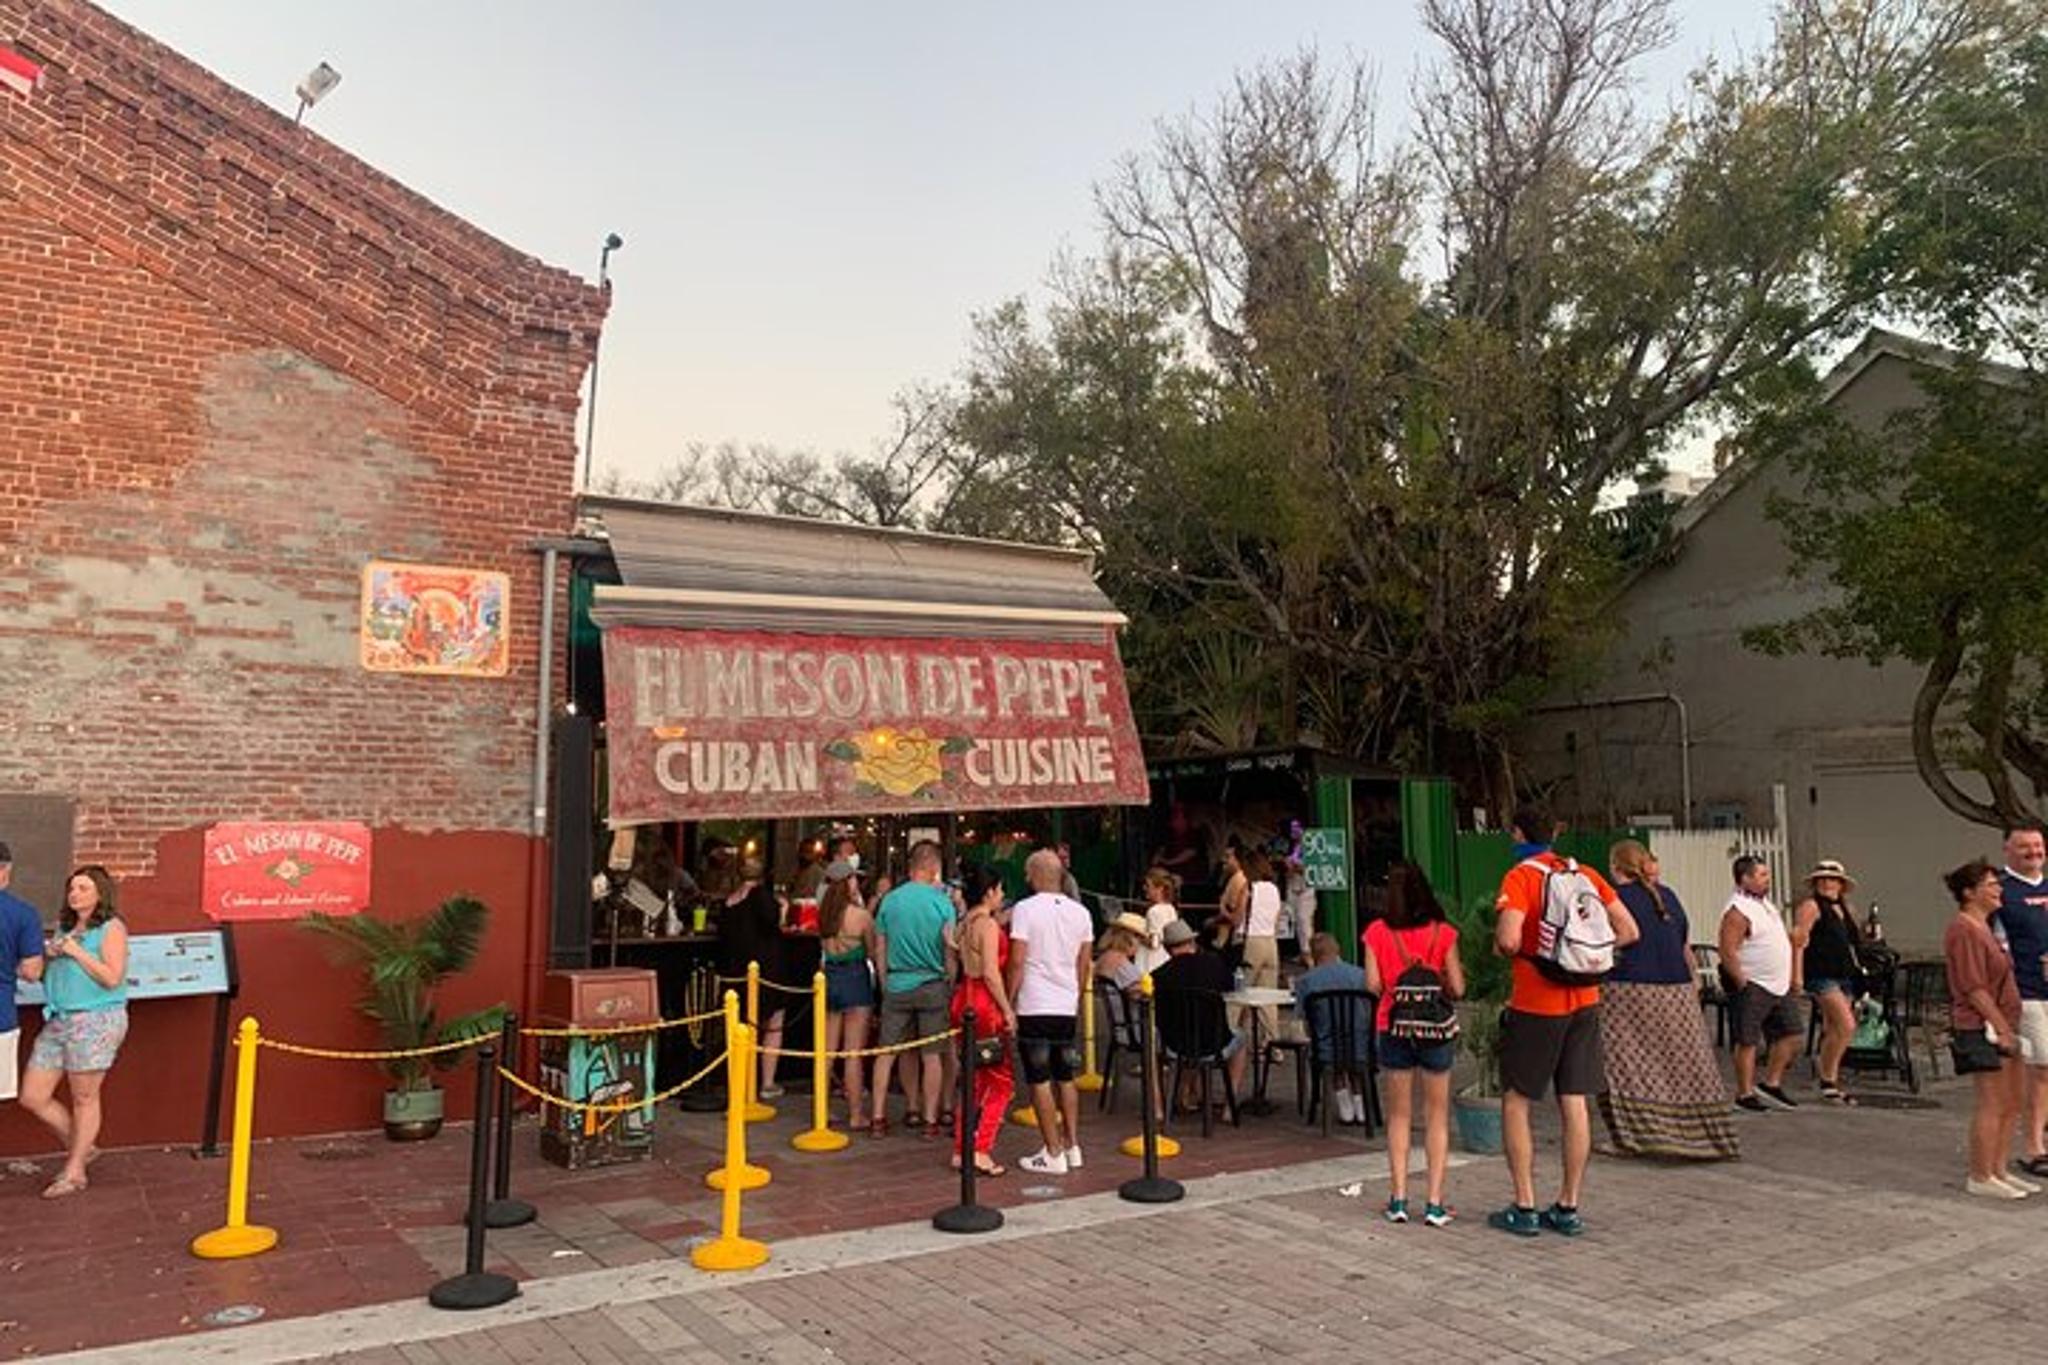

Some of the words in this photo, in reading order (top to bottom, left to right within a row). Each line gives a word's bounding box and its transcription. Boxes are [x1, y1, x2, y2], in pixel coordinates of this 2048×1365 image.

[633, 646, 696, 727] EL
[704, 649, 911, 720] MESON
[917, 655, 987, 717] DE
[991, 656, 1112, 728] PEPE
[655, 740, 818, 794] CUBAN
[965, 735, 1116, 786] CUISINE
[214, 843, 238, 866] EL
[243, 832, 300, 856] MESON
[304, 831, 325, 851] DE
[324, 837, 365, 865] PEPE
[1303, 831, 1326, 855] 90
[1305, 865, 1346, 887] CUBA
